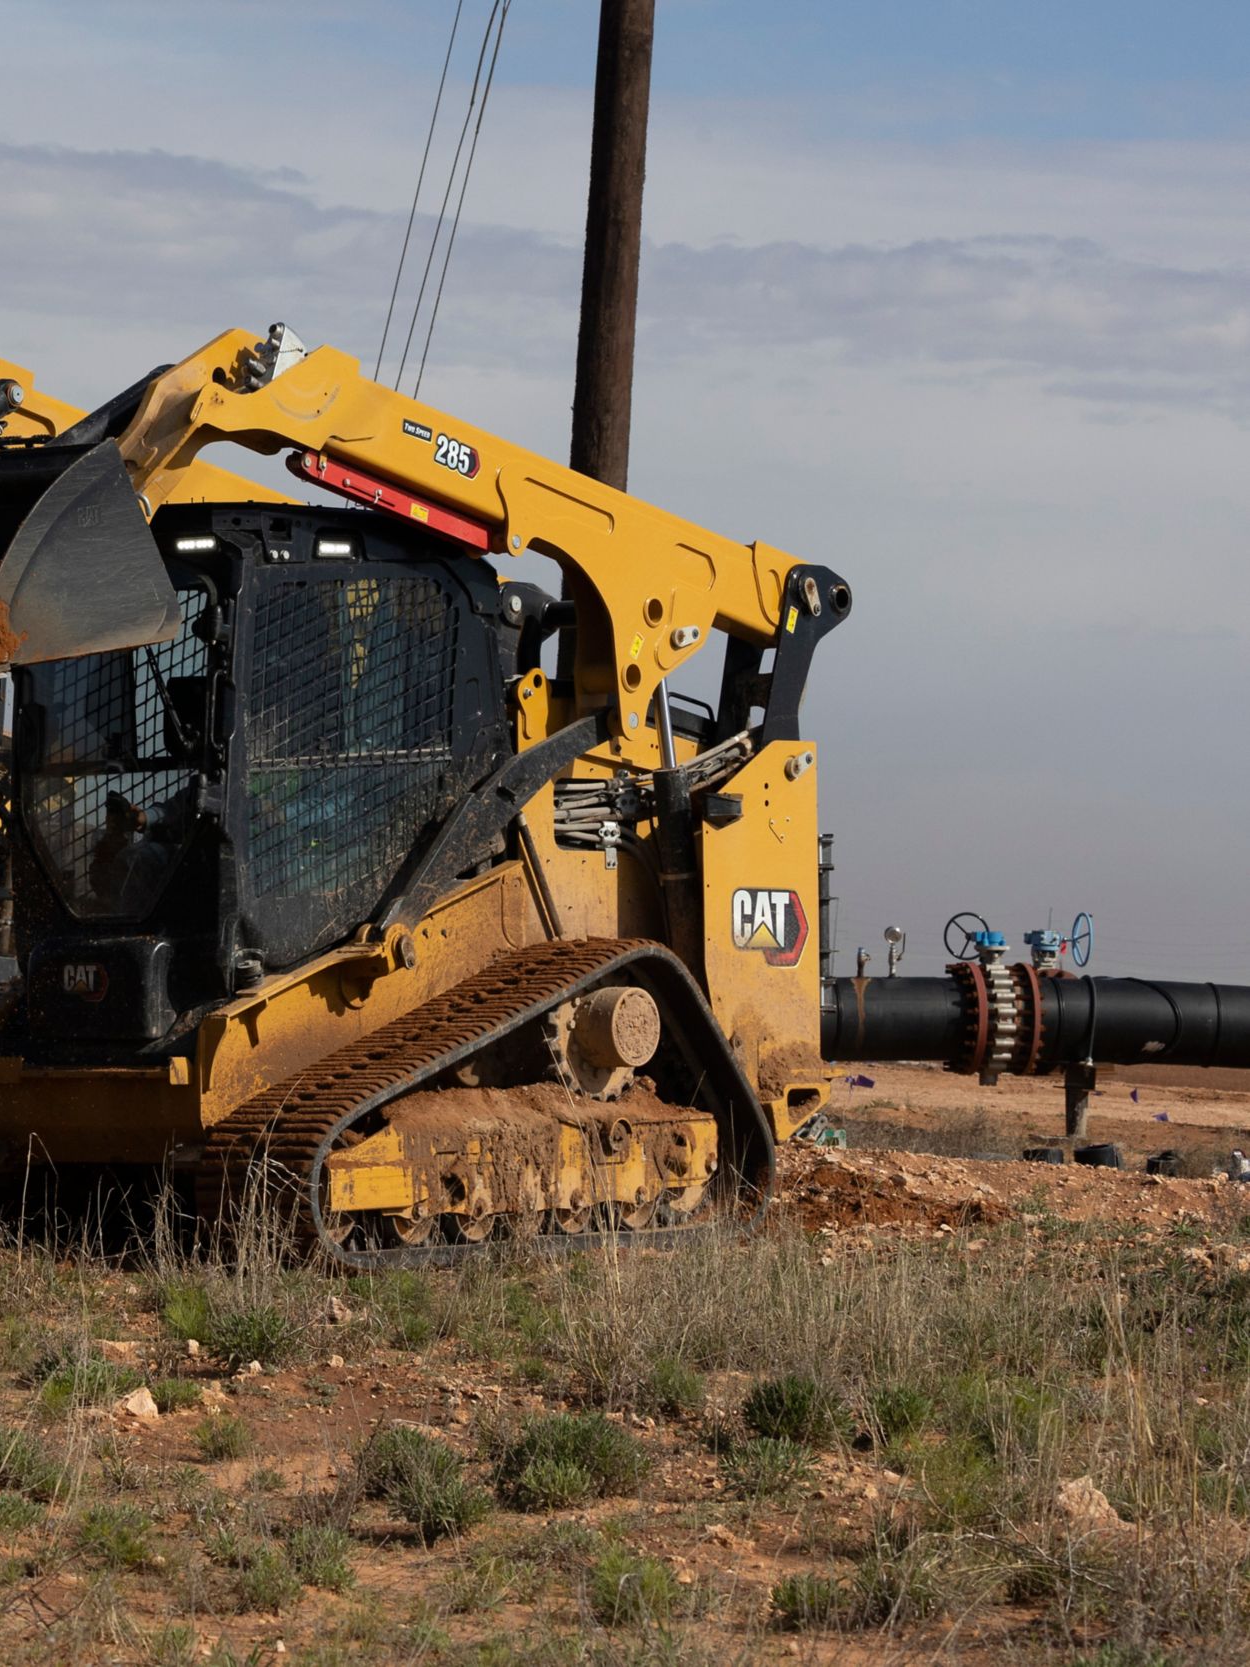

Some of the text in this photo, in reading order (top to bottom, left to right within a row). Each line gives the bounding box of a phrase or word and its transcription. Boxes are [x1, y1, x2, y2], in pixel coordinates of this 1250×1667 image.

[435, 434, 471, 474] 285
[733, 889, 790, 948] CAT
[63, 964, 98, 992] CAT
